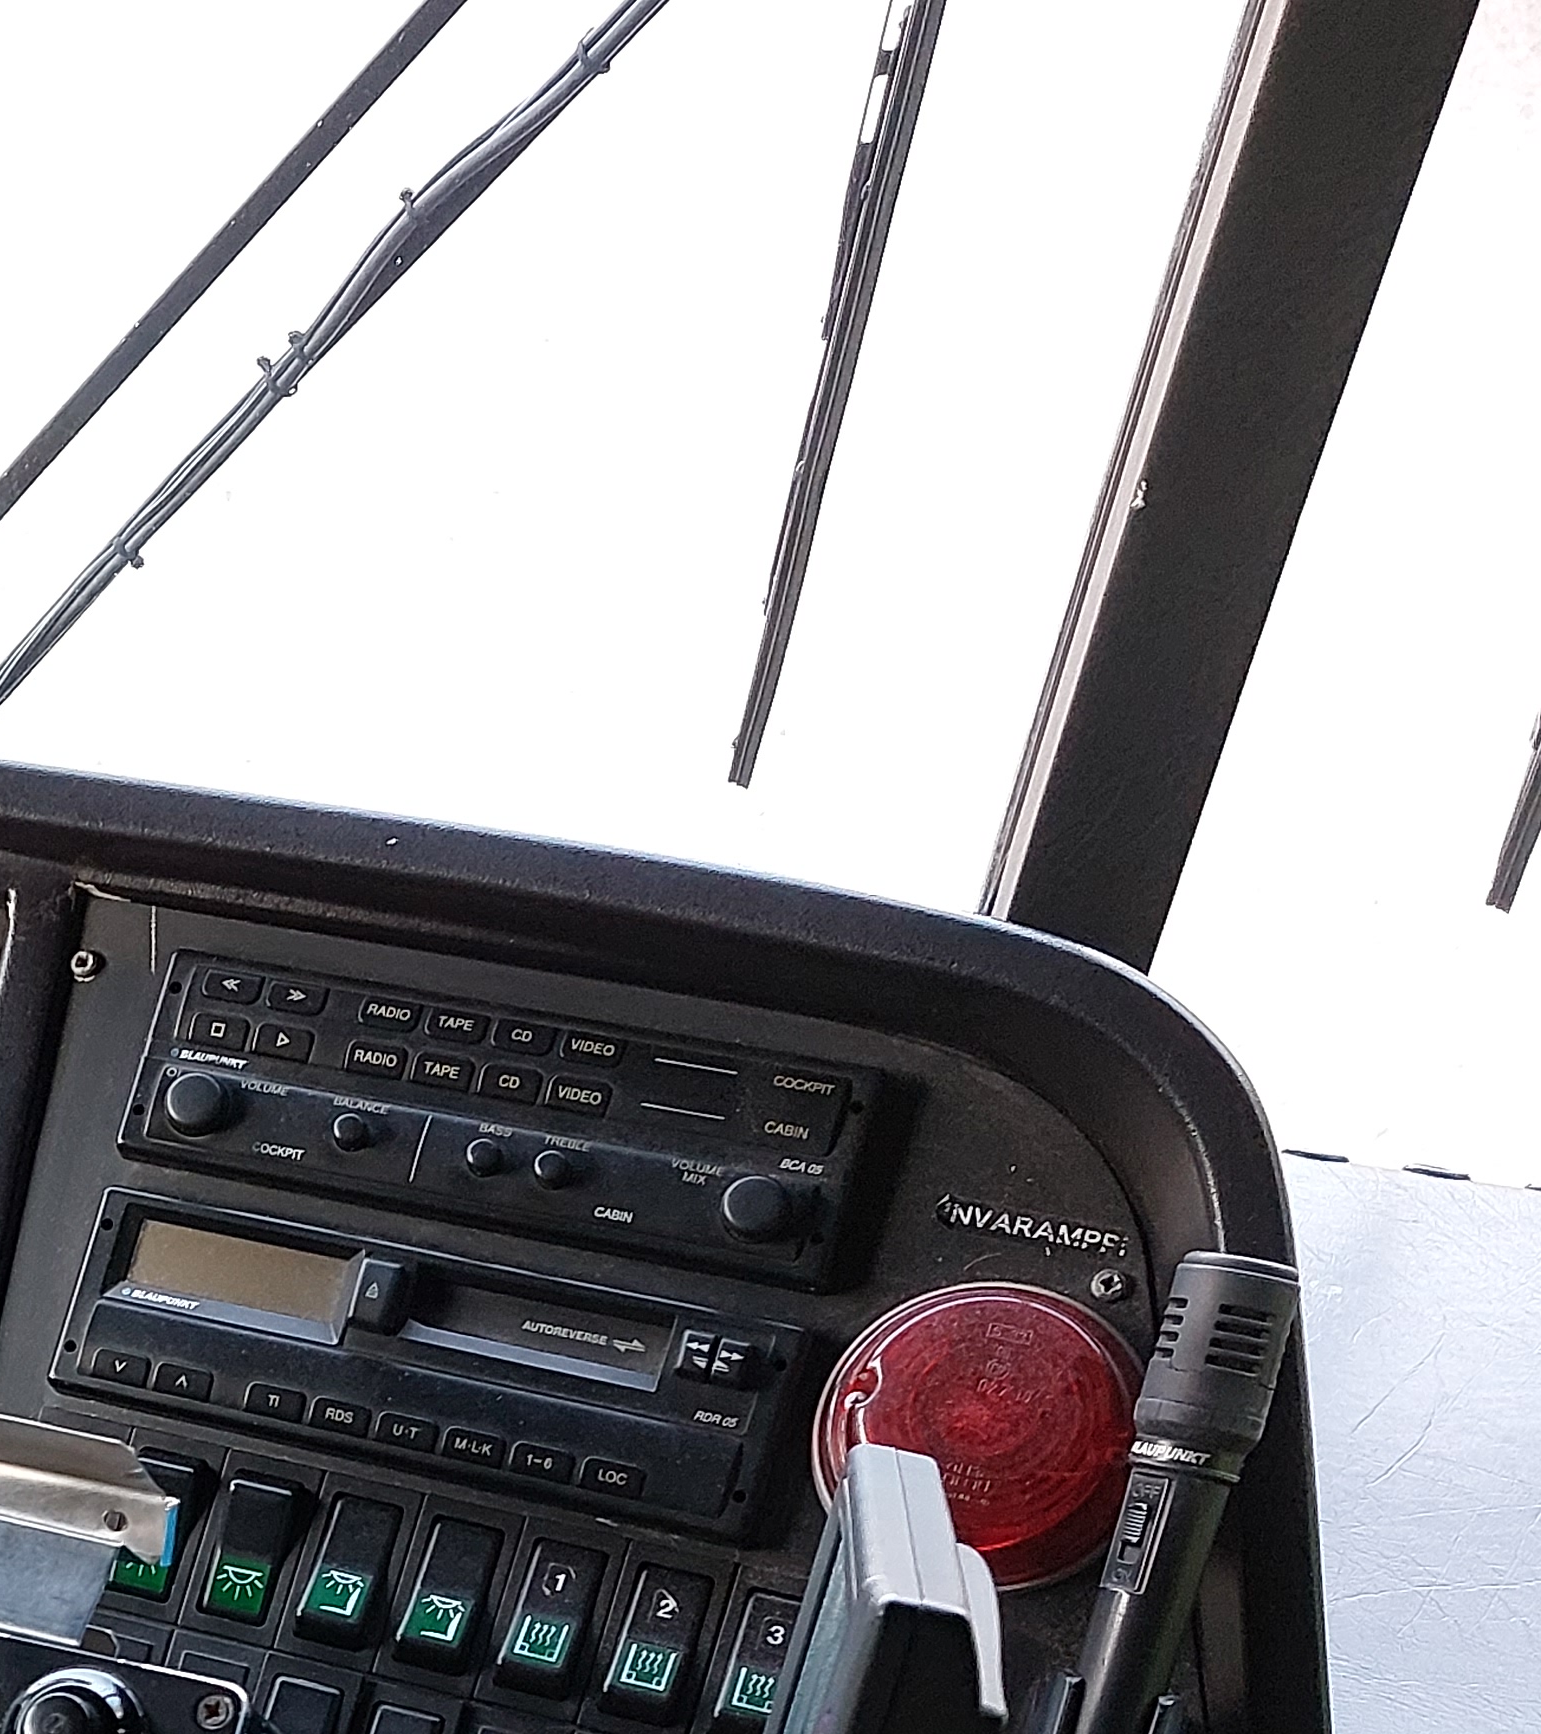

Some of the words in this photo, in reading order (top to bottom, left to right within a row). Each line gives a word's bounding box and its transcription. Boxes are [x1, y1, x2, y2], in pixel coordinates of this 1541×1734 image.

[367, 1004, 411, 1021] RADIO
[438, 1016, 475, 1031] TAPE
[511, 1029, 532, 1042] CD
[571, 1038, 615, 1057] VIDEO
[773, 1075, 835, 1096] COCKPIT
[179, 1049, 249, 1070] BLAUPUNKT
[240, 1079, 290, 1097] VOLUME
[353, 1049, 398, 1067] RADIO
[423, 1061, 461, 1079] TAPE
[499, 1075, 520, 1089] CD
[558, 1087, 602, 1105] VIDEO
[764, 1121, 810, 1140] CABIN
[333, 1096, 390, 1115] BALANCE
[478, 1122, 513, 1137] BASS
[252, 1141, 306, 1161] COCKPIT
[544, 1134, 591, 1152] TREBLE
[671, 1158, 725, 1176] VOLUME
[779, 1158, 805, 1172] BCA
[808, 1164, 825, 1175] 05
[682, 1171, 707, 1186] MIX
[594, 1207, 634, 1224] CABIN
[131, 1289, 200, 1310] BLAUPUNKT
[521, 1320, 609, 1346] AUTOREVERSE
[325, 1407, 354, 1424] RDS
[693, 1410, 721, 1425] RDR
[722, 1416, 740, 1429] 05
[597, 1468, 628, 1486] LOC
[1132, 1483, 1162, 1499] OFF
[554, 1573, 567, 1591] 1
[656, 1599, 674, 1619] 2
[766, 1625, 785, 1645] 3
